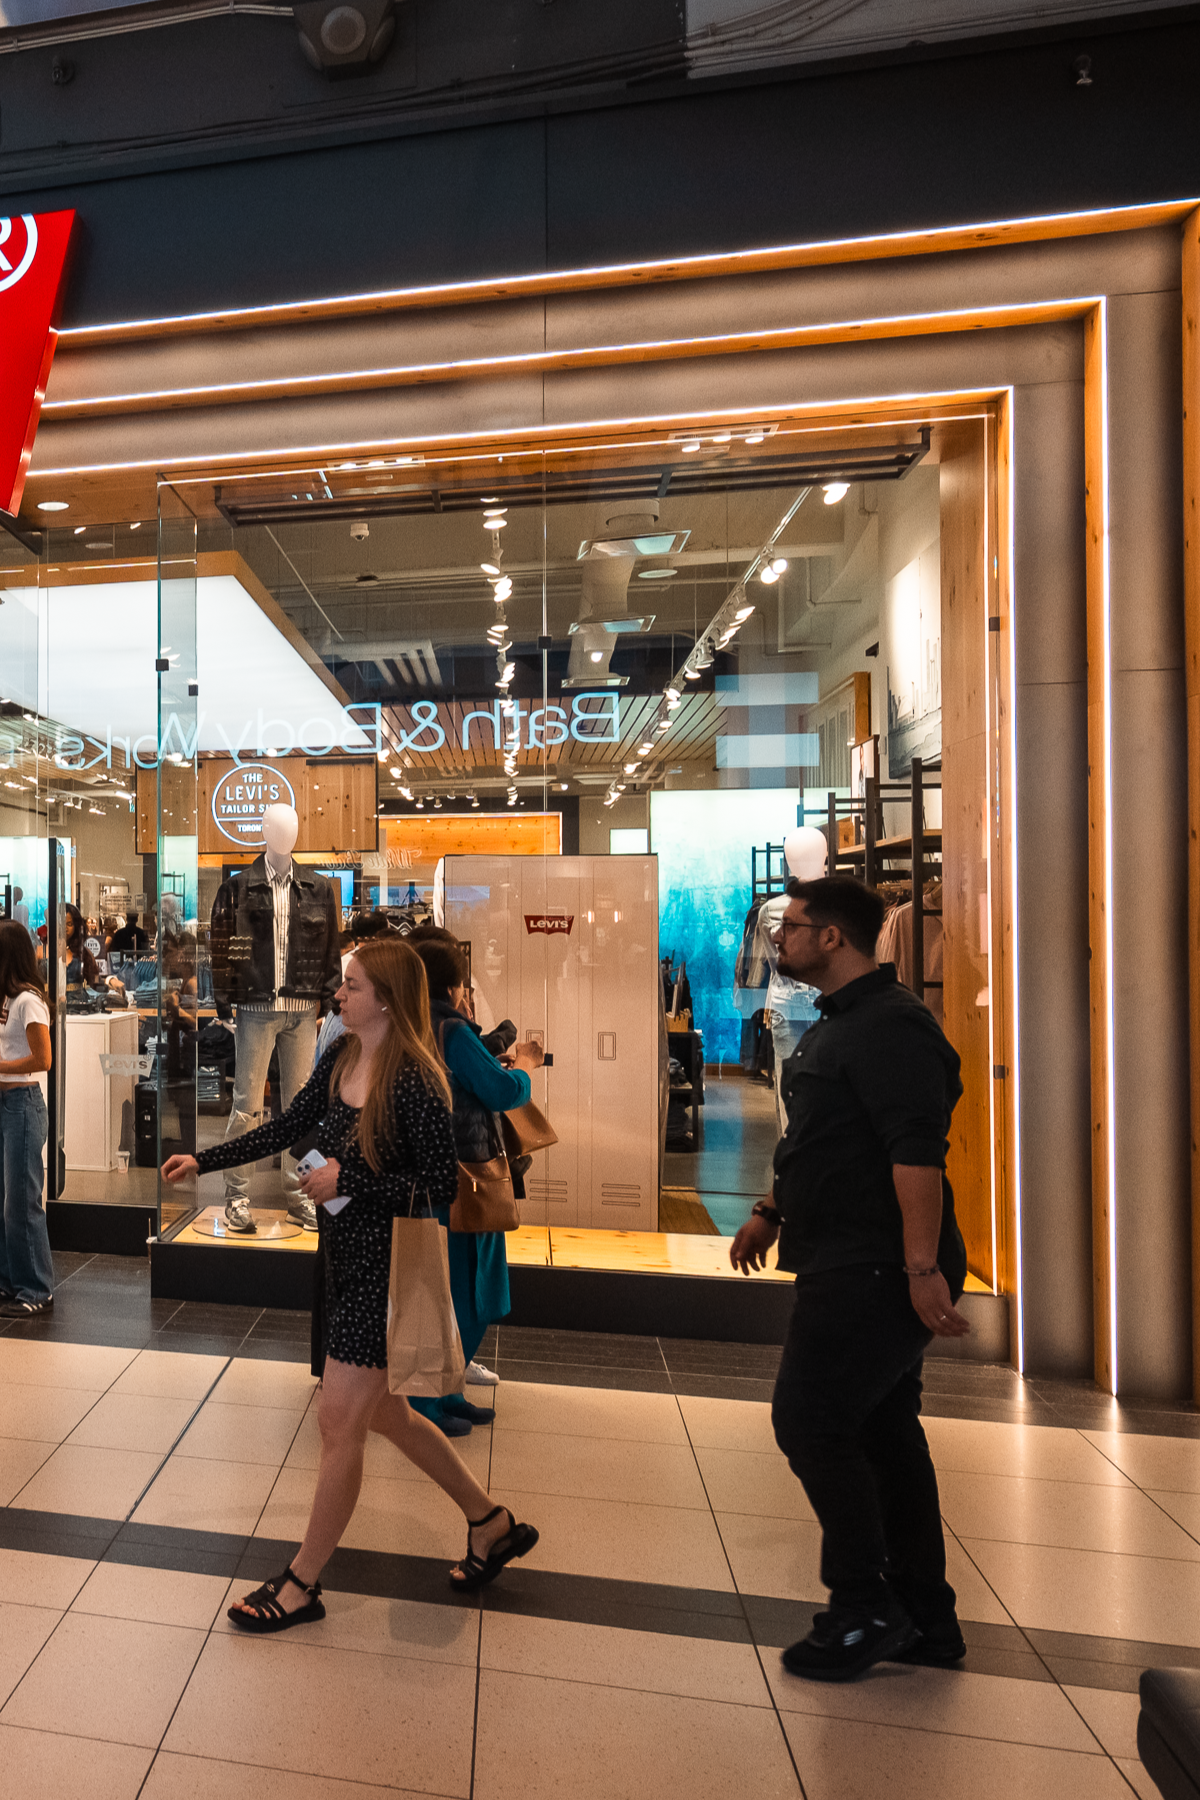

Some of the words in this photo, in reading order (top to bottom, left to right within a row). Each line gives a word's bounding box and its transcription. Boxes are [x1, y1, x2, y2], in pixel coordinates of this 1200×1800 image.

[242, 773, 263, 783] THE
[225, 784, 280, 801] LEVI'S
[220, 804, 256, 814] TAILOR
[237, 823, 264, 833] TORON
